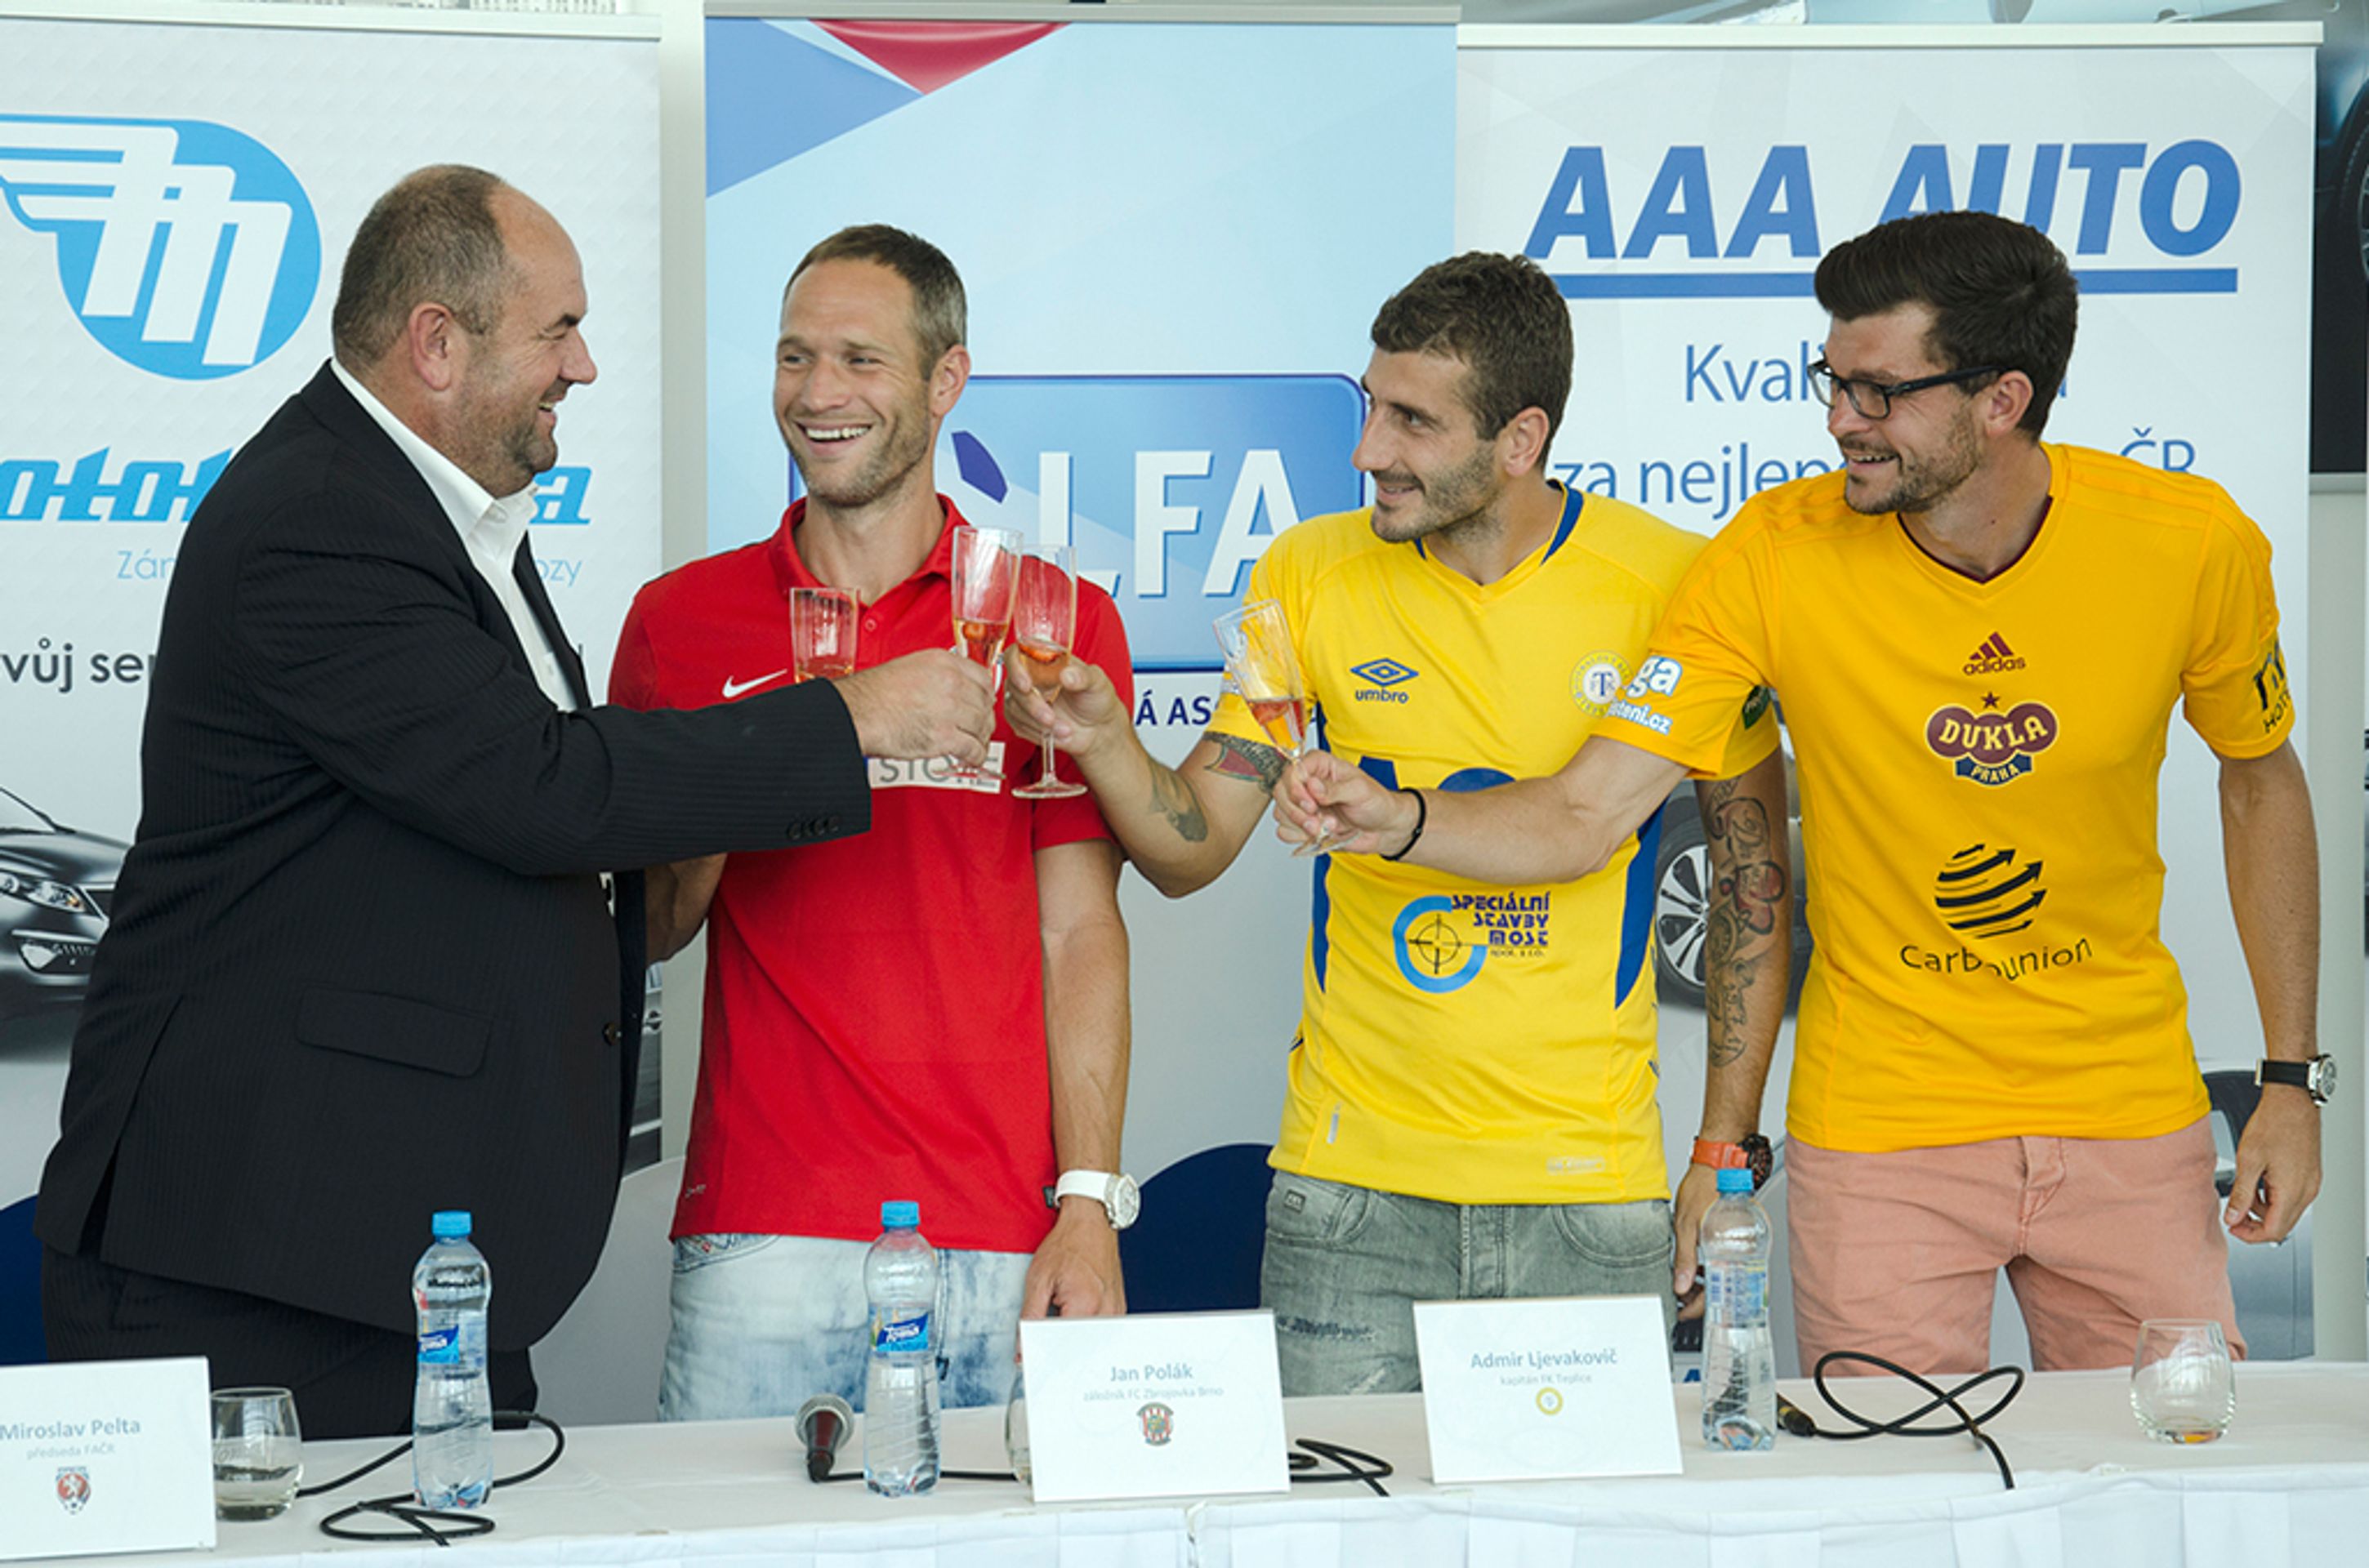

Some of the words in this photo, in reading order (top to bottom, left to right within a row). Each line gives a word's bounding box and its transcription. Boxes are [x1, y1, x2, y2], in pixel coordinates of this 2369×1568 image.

[1524, 145, 1822, 259] AAA
[1879, 139, 2242, 257] AUTO
[1685, 341, 1826, 403] Kval
[1038, 449, 1300, 598] LFA
[1626, 655, 1683, 697] ga
[1963, 657, 2027, 676] adidas
[1354, 688, 1409, 704] umbro
[1938, 715, 2048, 751] DUKLA
[1970, 764, 2021, 783] PRAHA
[1452, 890, 1550, 911] SPECIÁLNÍ
[1474, 912, 1550, 929] STAVBY
[1489, 929, 1549, 946] MOST
[1471, 1352, 1522, 1368] Admir
[1528, 1348, 1617, 1370] Ljevakovič
[1110, 1367, 1139, 1382] Jan
[1144, 1363, 1193, 1380] Polák
[0, 1421, 85, 1440] Miroslav
[91, 1418, 141, 1435] Pelta
